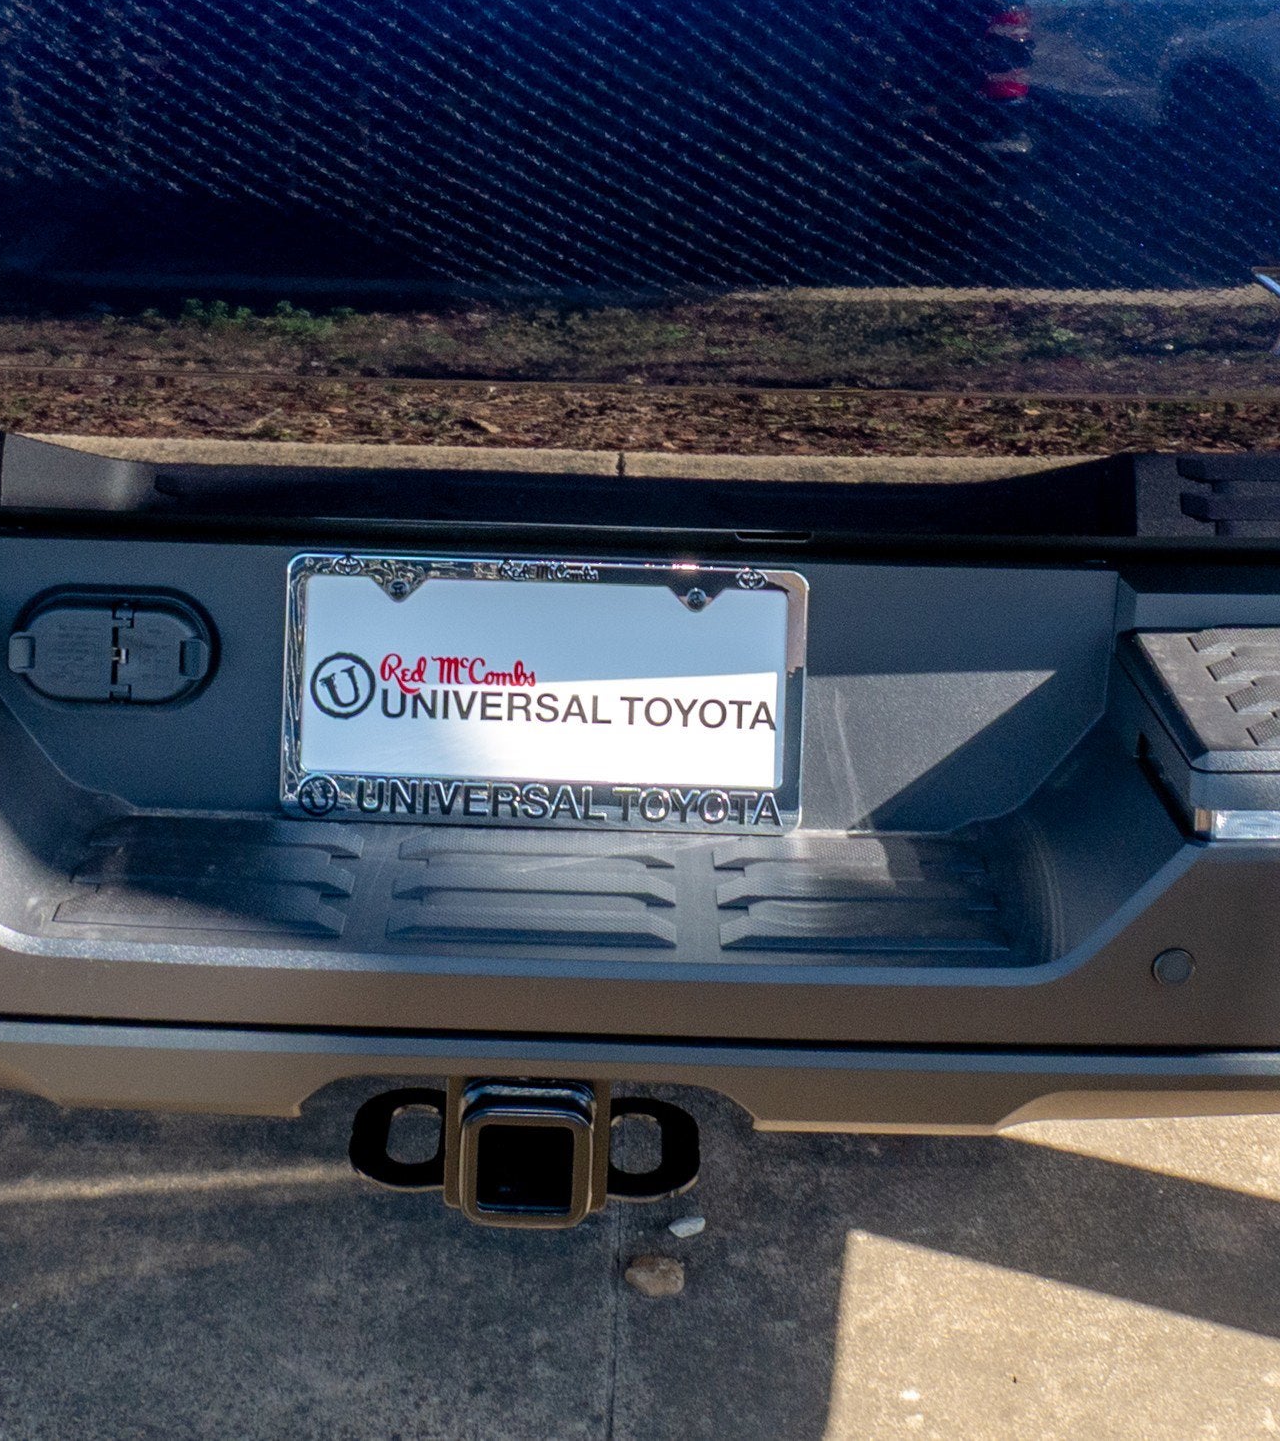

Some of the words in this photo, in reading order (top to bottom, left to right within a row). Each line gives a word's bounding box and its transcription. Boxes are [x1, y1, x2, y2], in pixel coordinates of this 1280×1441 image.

[500, 558, 529, 581] Red
[380, 653, 427, 695] Red
[431, 655, 536, 687] McCombs
[380, 688, 612, 725] UNIVERSAL
[619, 696, 778, 731] TOYOTA
[356, 777, 608, 821] UNIVERSAL
[611, 786, 784, 827] TOYOTA
